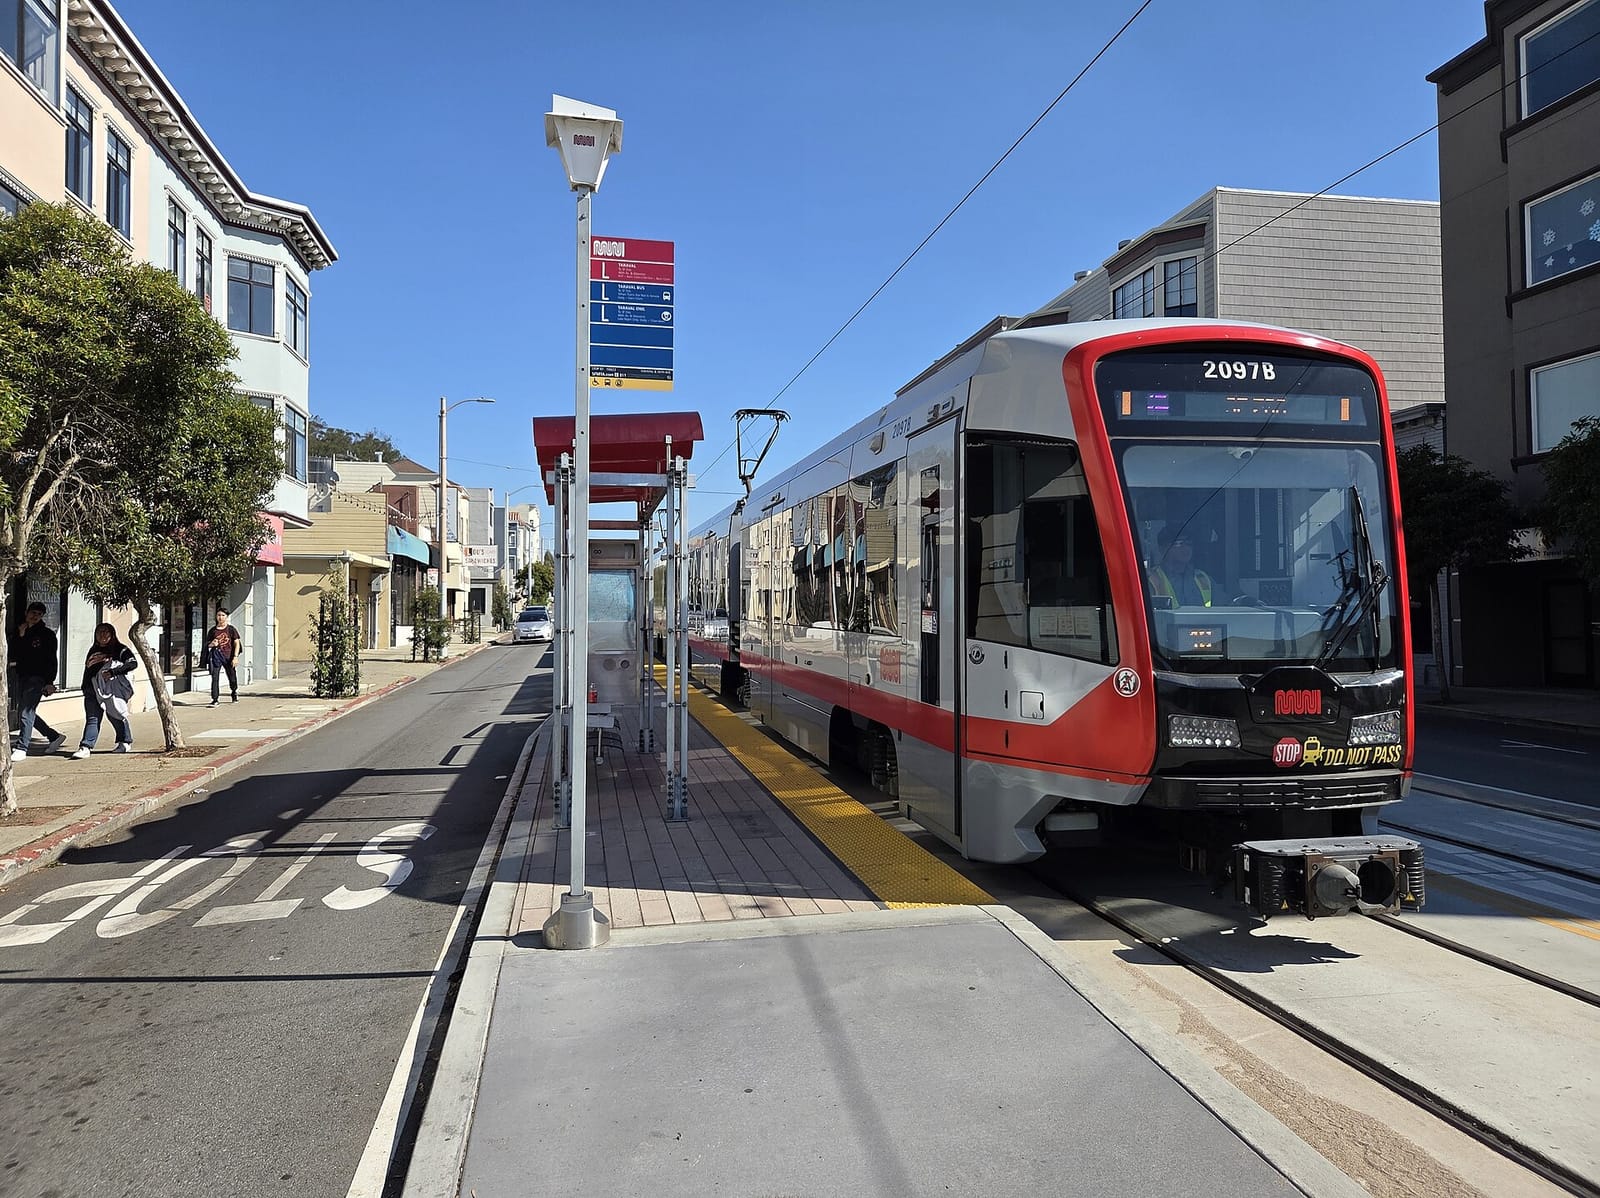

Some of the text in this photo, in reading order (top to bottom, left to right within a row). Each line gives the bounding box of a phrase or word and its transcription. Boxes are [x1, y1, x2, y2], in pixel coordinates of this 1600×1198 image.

[602, 261, 610, 279] L
[602, 283, 610, 300] L
[601, 304, 609, 321] L
[1202, 360, 1276, 381] 2097B
[892, 416, 912, 439] 2097B
[1274, 689, 1322, 715] MUNI
[1275, 744, 1301, 763] STOP
[1325, 744, 1402, 766] DO NOT PASS
